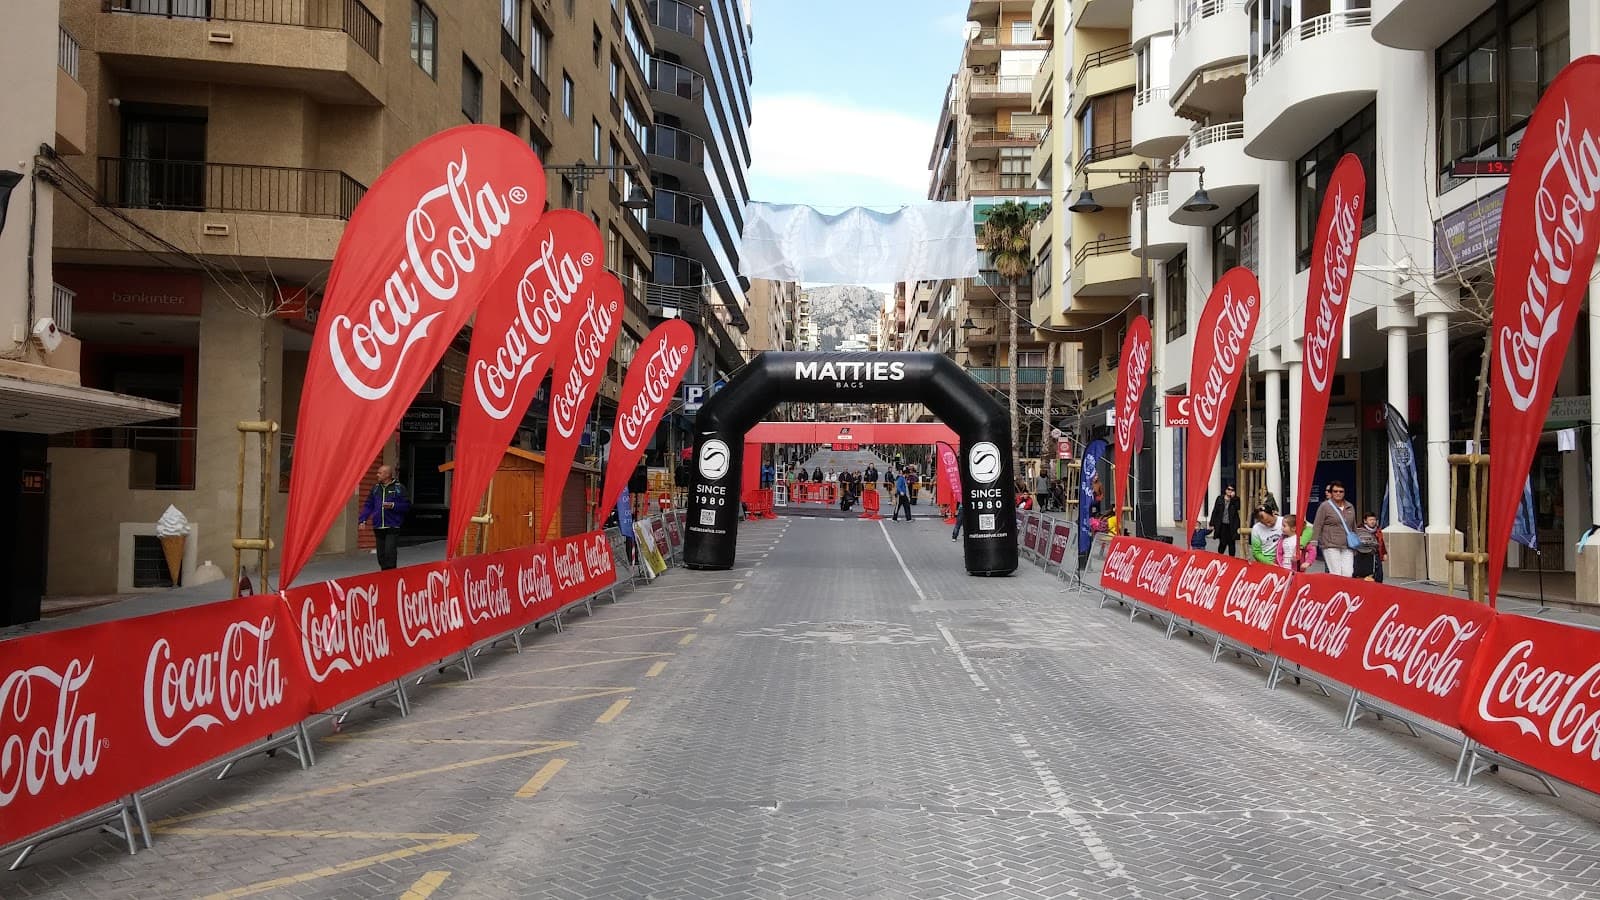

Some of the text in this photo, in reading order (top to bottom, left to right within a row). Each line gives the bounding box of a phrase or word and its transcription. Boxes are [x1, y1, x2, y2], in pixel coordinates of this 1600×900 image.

[329, 146, 510, 400] Coca-Cola
[474, 229, 583, 420] Coca-Cola
[553, 290, 611, 438] Coca-Cola
[1194, 284, 1250, 437] Coca-Cola
[619, 334, 681, 450] Coca-Cola
[689, 387, 703, 403] P
[795, 361, 905, 381] MATTIES
[1025, 406, 1059, 415] GUINSS
[696, 496, 724, 506] 1980
[697, 484, 726, 495] SINCE
[971, 489, 1001, 498] SINCE
[971, 501, 1002, 509] 1980
[302, 568, 463, 683] Coca-Cola Coca-Cola
[464, 563, 511, 624] Coca-Cola
[144, 616, 284, 747] Coca-Cola
[1282, 584, 1481, 697] Coca-Cola Coca-Cola
